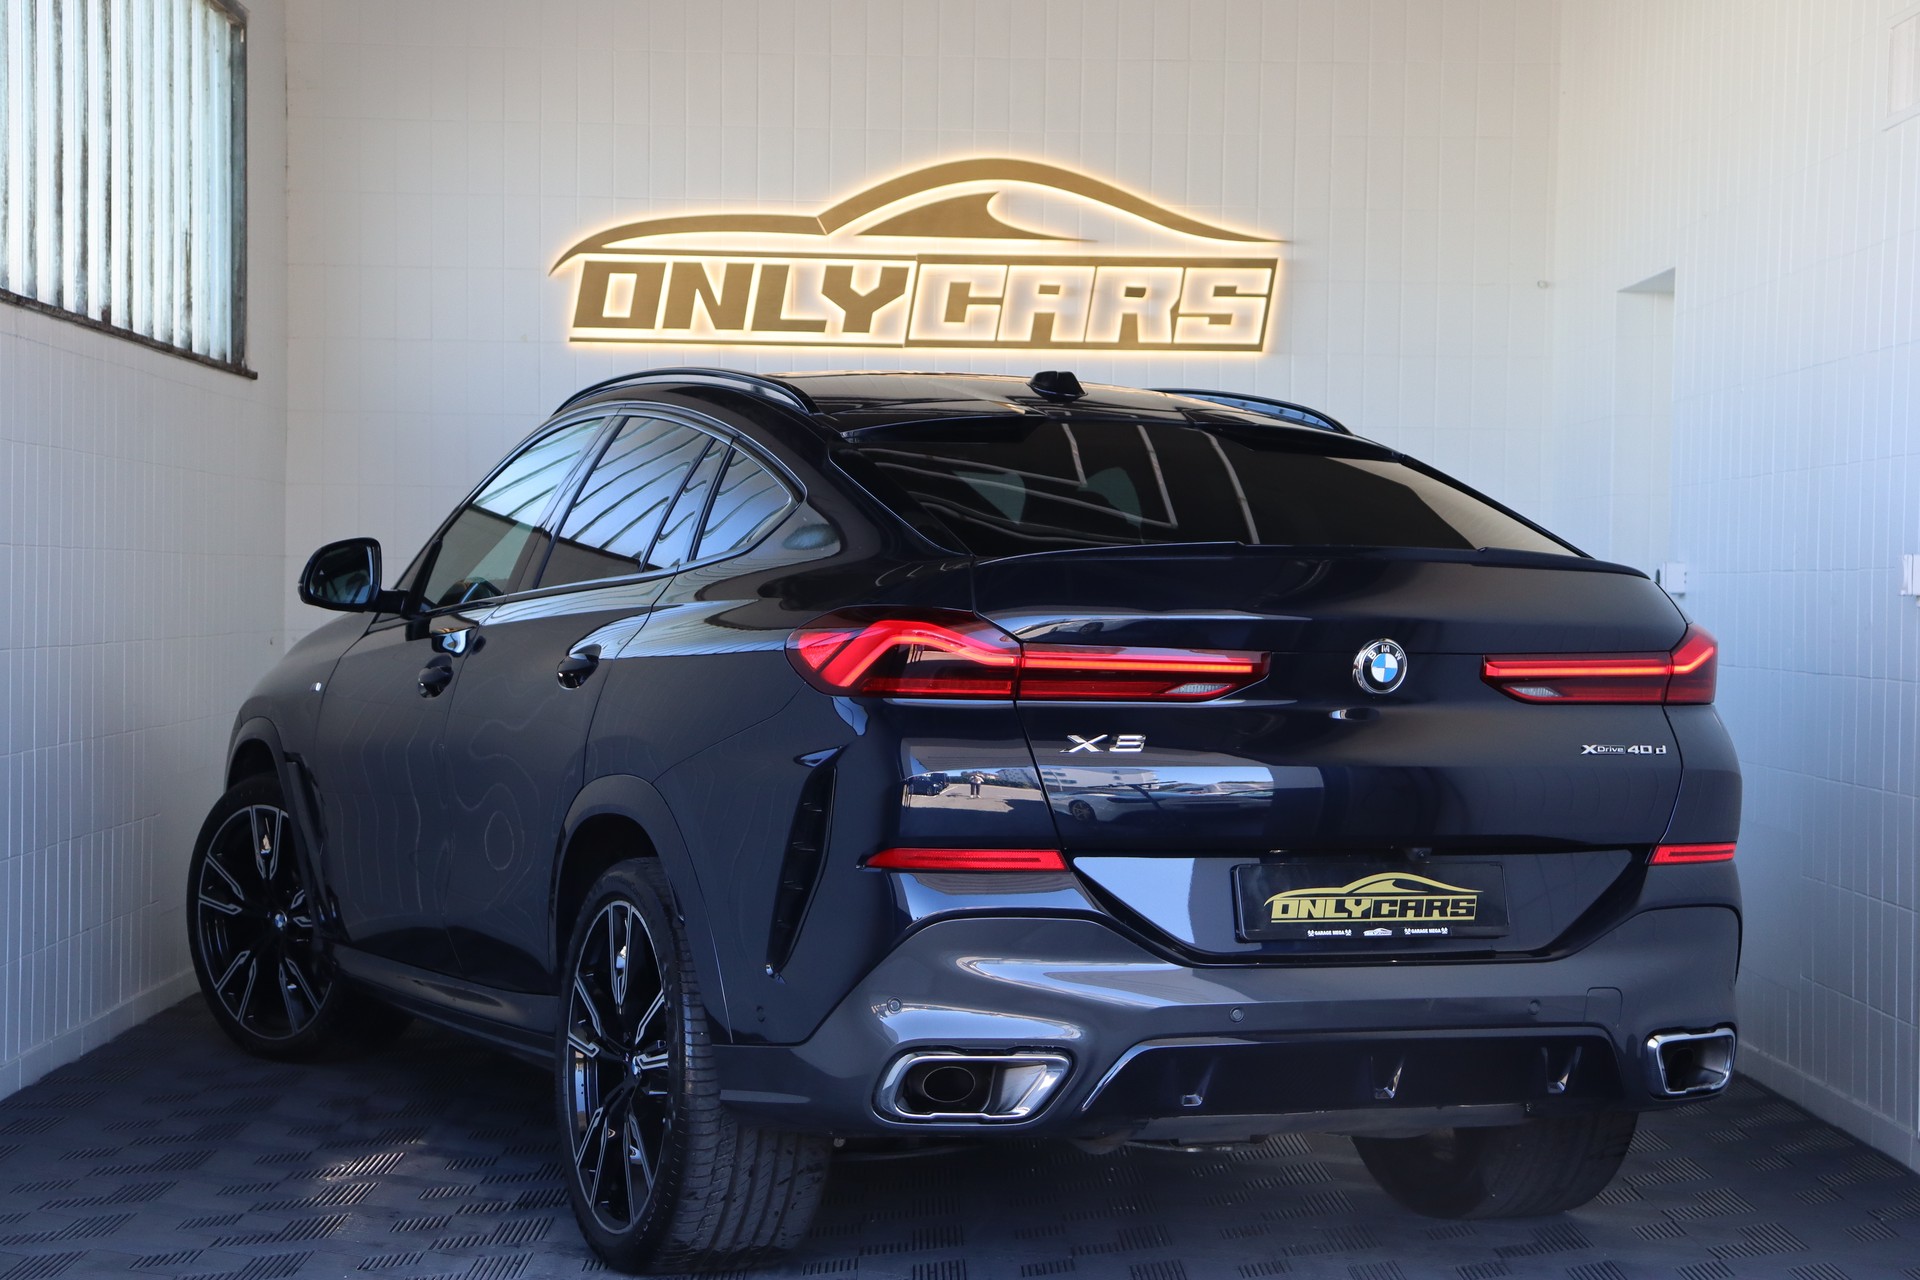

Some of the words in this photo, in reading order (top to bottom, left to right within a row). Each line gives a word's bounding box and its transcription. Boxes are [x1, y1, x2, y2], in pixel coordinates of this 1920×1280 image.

[572, 259, 1273, 344] ONLYCARS
[1367, 645, 1403, 661] BMW
[1271, 898, 1476, 920] ONLYCARS
